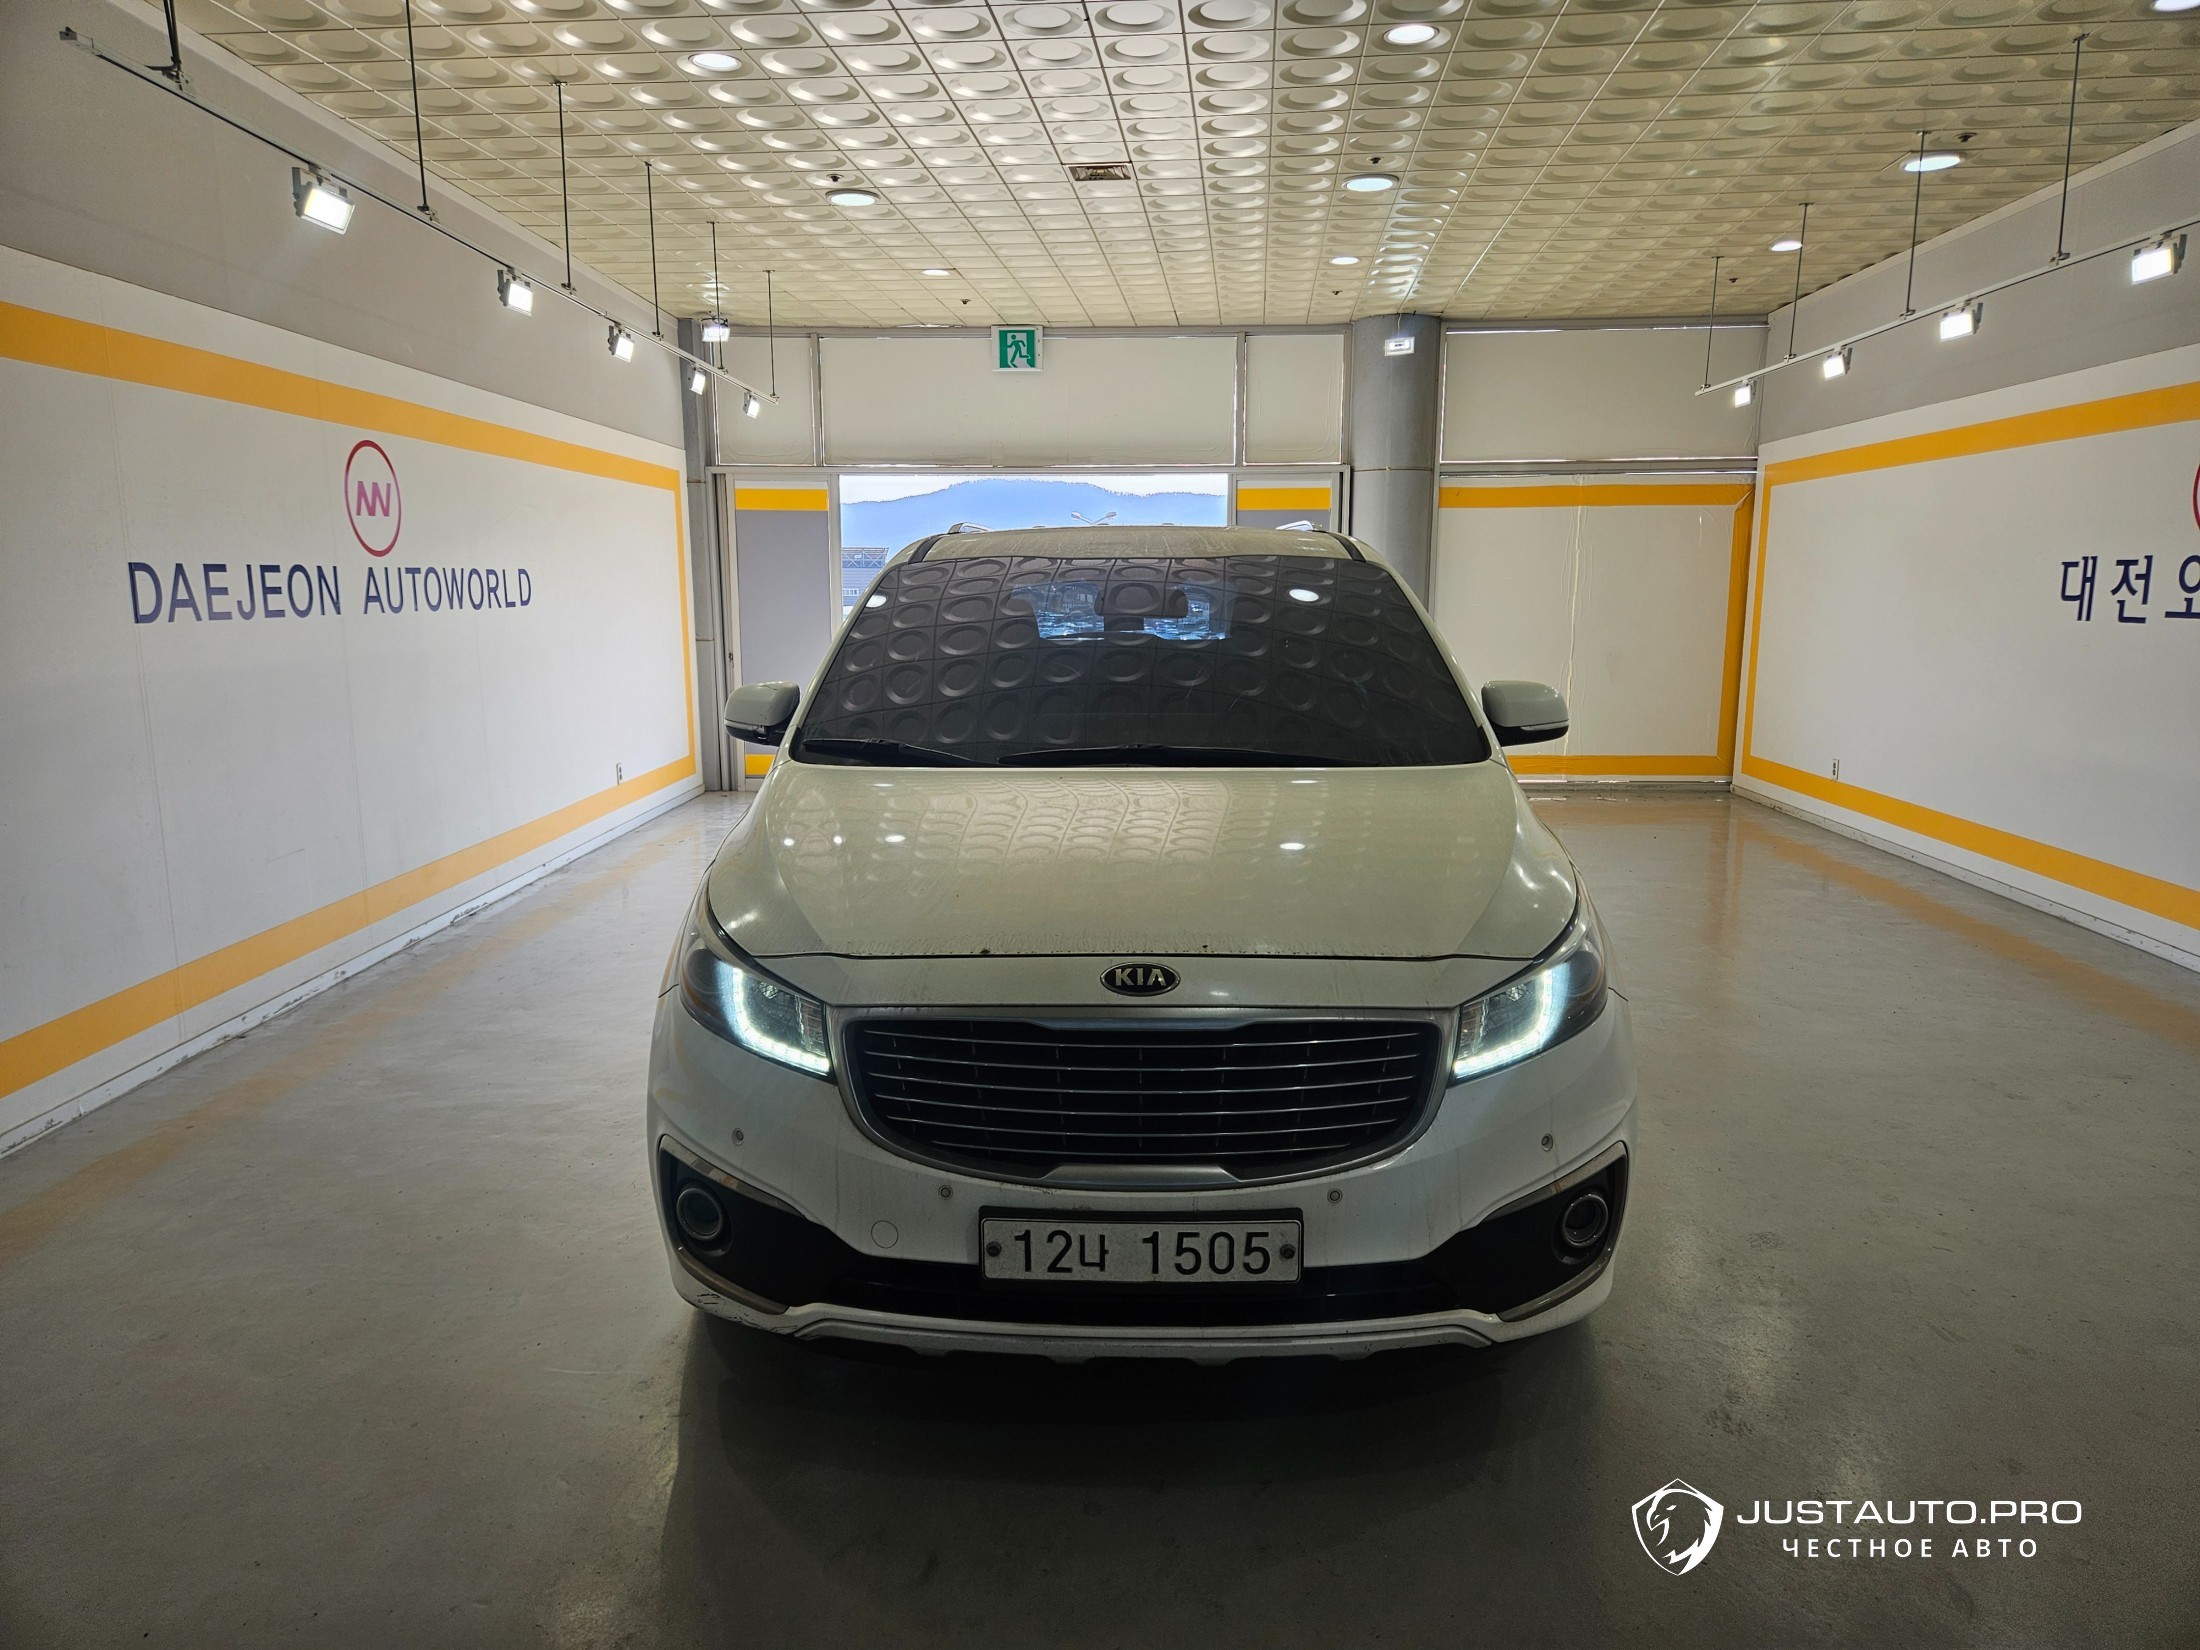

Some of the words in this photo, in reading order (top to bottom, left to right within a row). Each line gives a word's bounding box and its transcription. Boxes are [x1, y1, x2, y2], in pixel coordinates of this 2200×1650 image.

[127, 561, 342, 625] DAEJEON
[363, 566, 532, 615] AUTOWORLD
[1114, 967, 1167, 987] KIA
[1013, 1229, 1110, 1274] 12나
[1141, 1230, 1271, 1275] 1505
